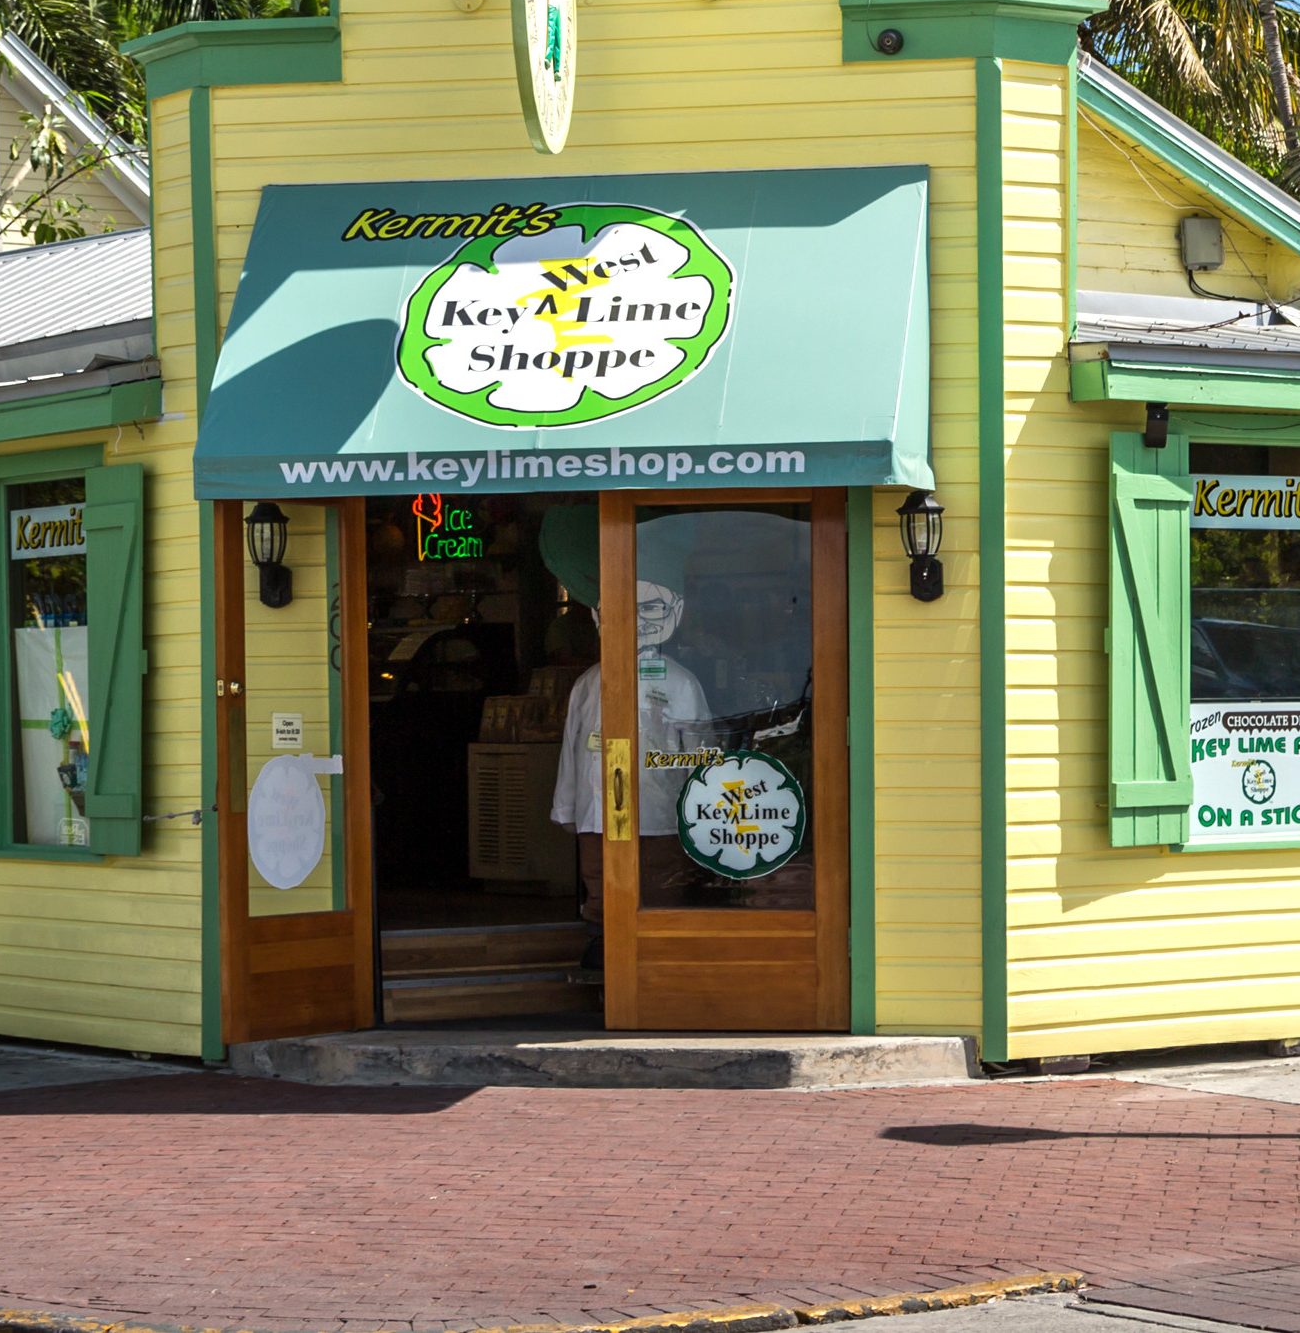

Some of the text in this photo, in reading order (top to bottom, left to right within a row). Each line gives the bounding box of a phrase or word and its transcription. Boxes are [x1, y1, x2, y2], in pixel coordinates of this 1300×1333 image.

[341, 202, 561, 242] Kermit's
[541, 241, 659, 293] West
[440, 295, 702, 334] Key Lime
[468, 343, 655, 379] Shoppe
[279, 447, 807, 487] www.keylimeshop.com
[16, 507, 86, 551] Kermit
[444, 504, 473, 532] Ice
[425, 533, 483, 559] Cream
[1190, 711, 1221, 735] rozen
[1227, 714, 1288, 727] CHOCOLATE
[644, 747, 725, 769] Kermit's
[1191, 737, 1230, 763] KEY
[1238, 736, 1286, 753] LIME
[721, 779, 768, 805] West
[696, 803, 790, 824] Key Lime
[1198, 804, 1232, 827] ON
[1240, 809, 1254, 826] A
[709, 828, 780, 850] Shoppe
